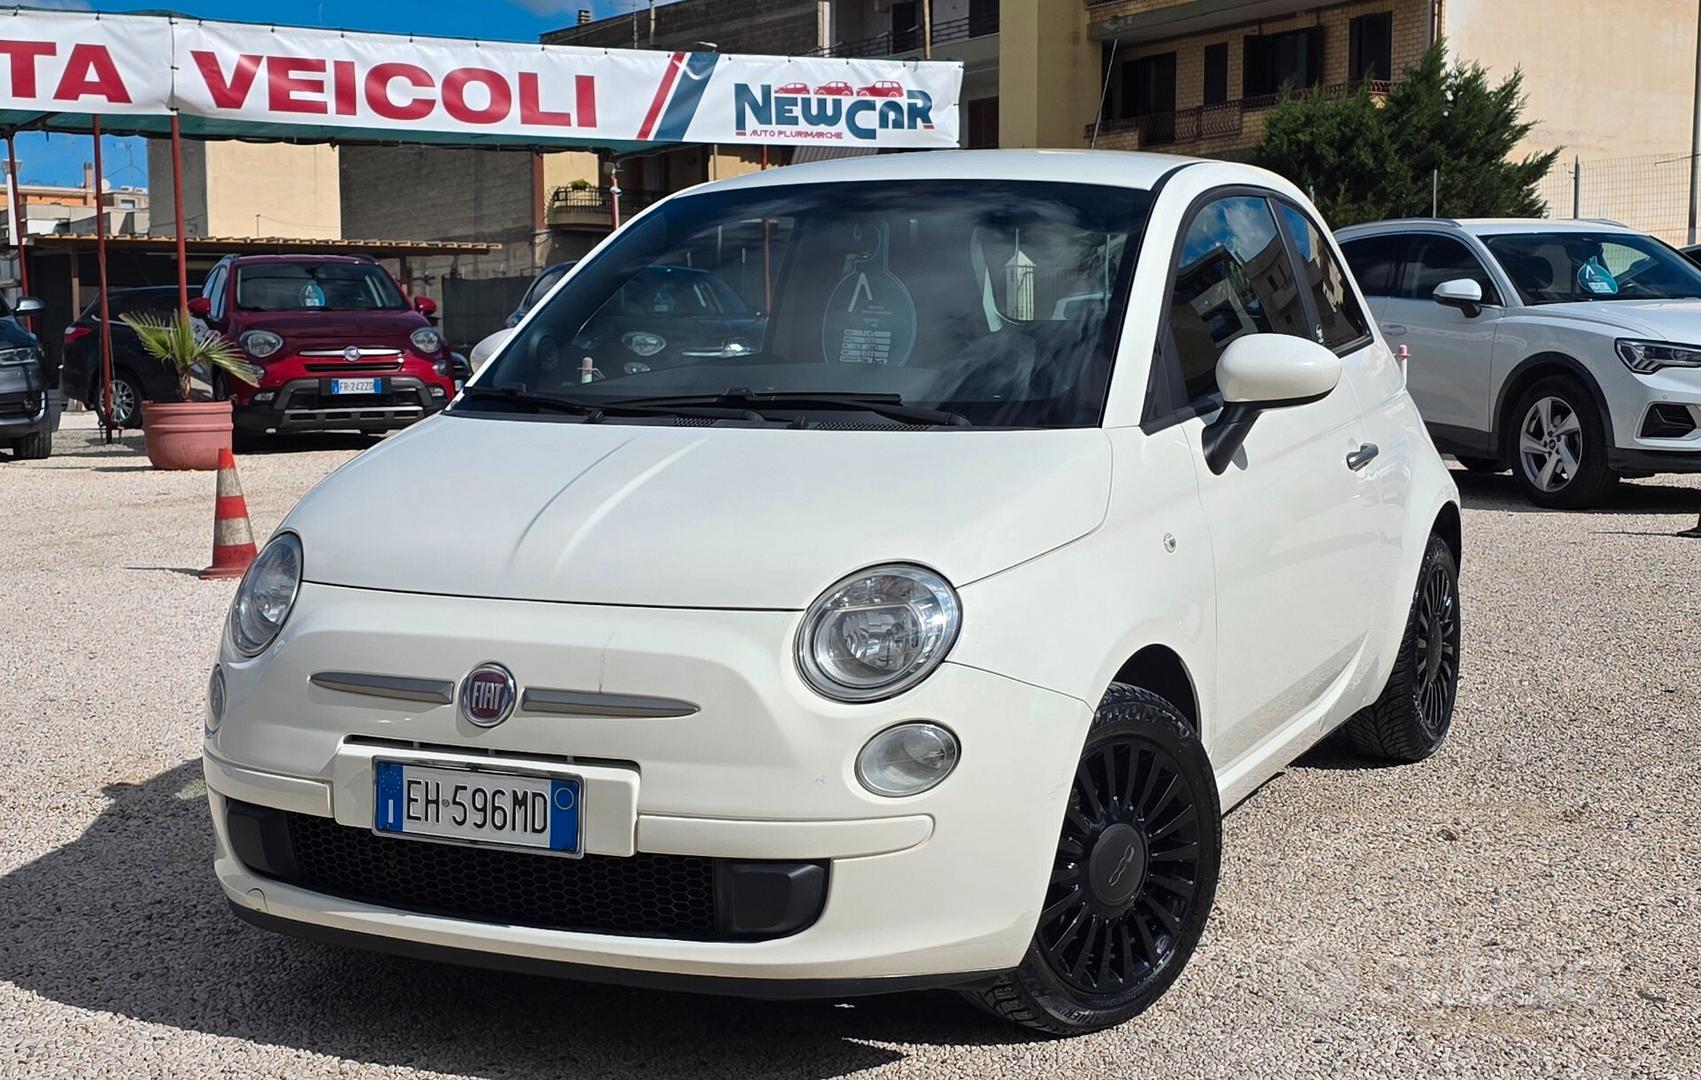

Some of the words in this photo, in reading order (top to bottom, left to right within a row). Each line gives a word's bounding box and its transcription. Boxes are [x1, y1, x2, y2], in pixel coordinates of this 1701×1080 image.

[191, 50, 598, 128] VEICOLI
[749, 130, 776, 138] AUTO
[778, 130, 843, 140] PLURIMARCHE
[471, 680, 504, 711] FIAT
